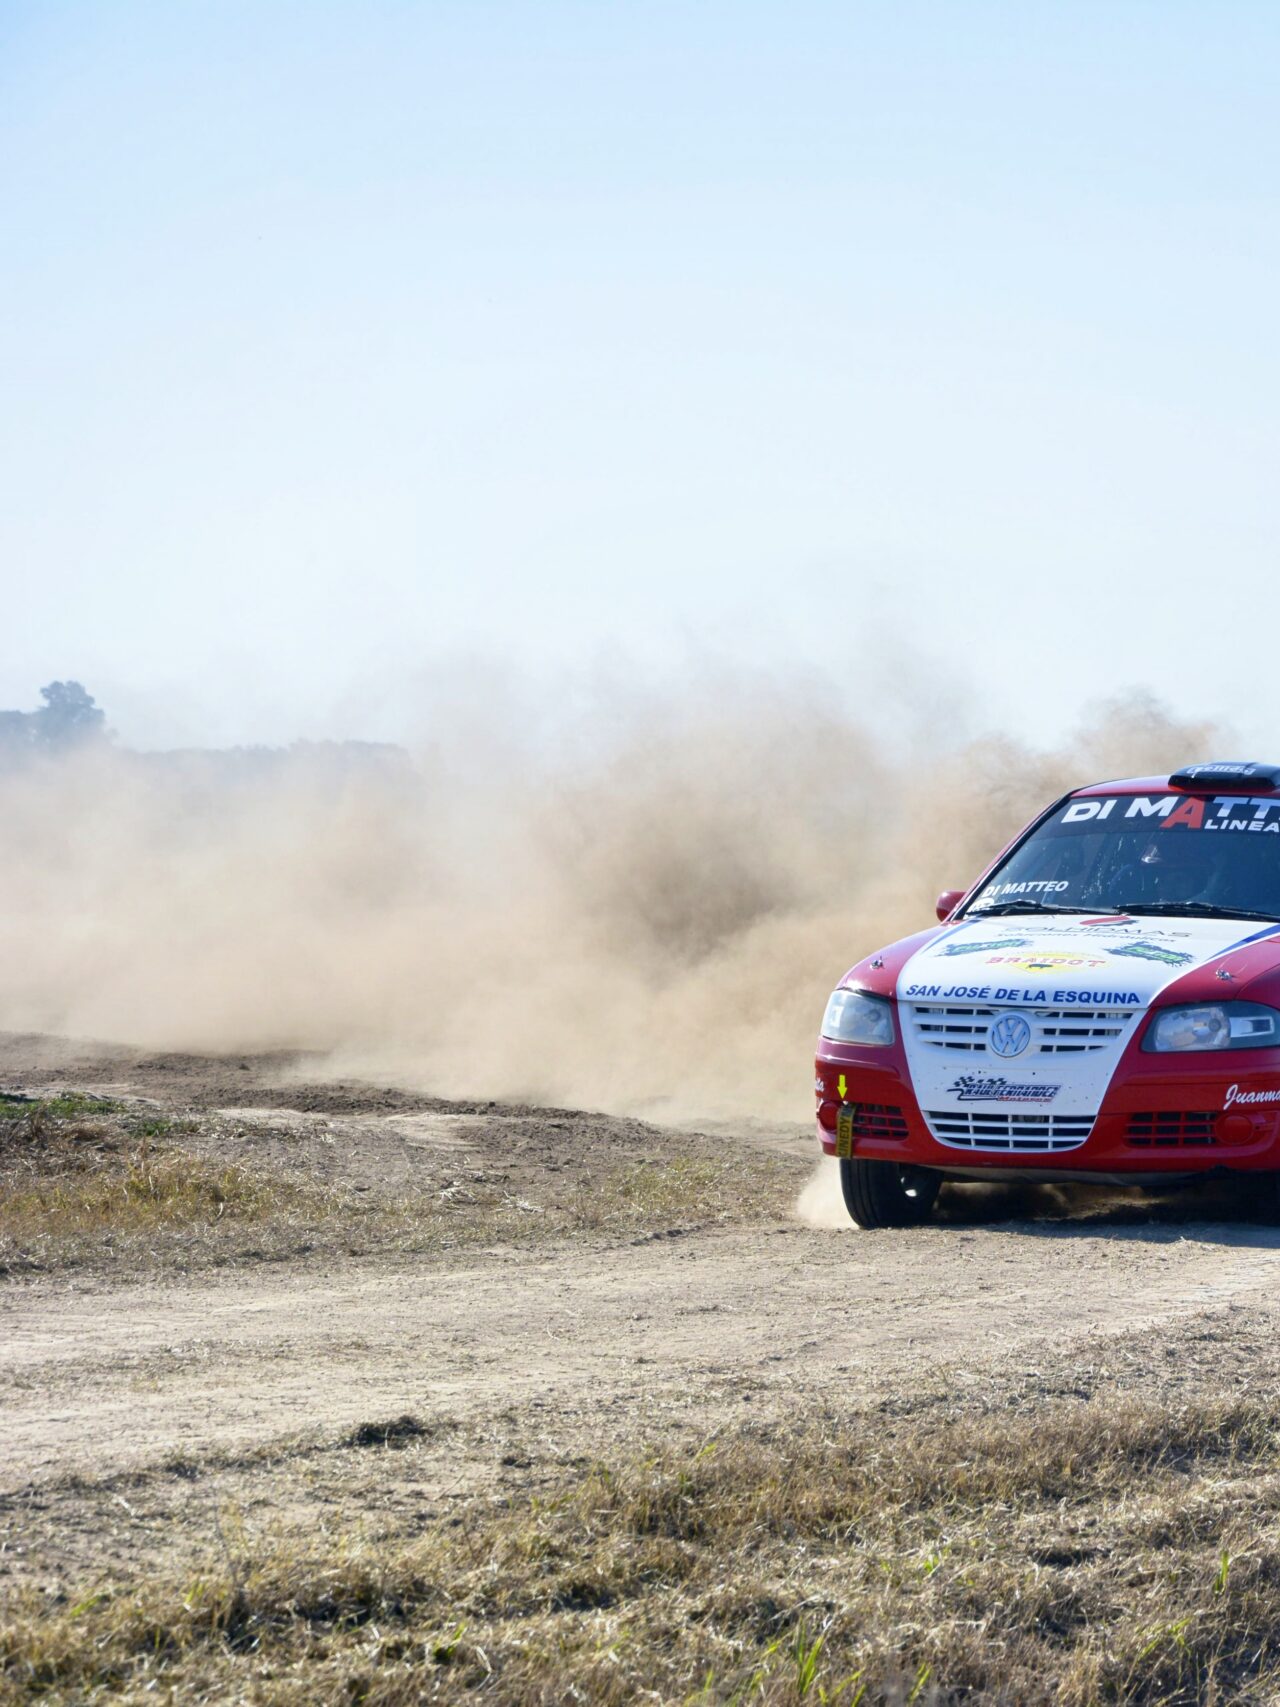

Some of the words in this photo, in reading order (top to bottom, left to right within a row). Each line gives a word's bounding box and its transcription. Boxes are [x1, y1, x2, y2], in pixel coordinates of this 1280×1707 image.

[1061, 799, 1118, 823] DI
[984, 885, 999, 897] DI
[1001, 880, 1069, 895] MATTEO
[985, 957, 1106, 968] BRAIDOT
[906, 984, 939, 997] SAN
[944, 985, 991, 998] JOSÉ
[994, 988, 1020, 1000] DE
[1022, 989, 1047, 1002] LA
[1052, 990, 1141, 1004] ESQUINA
